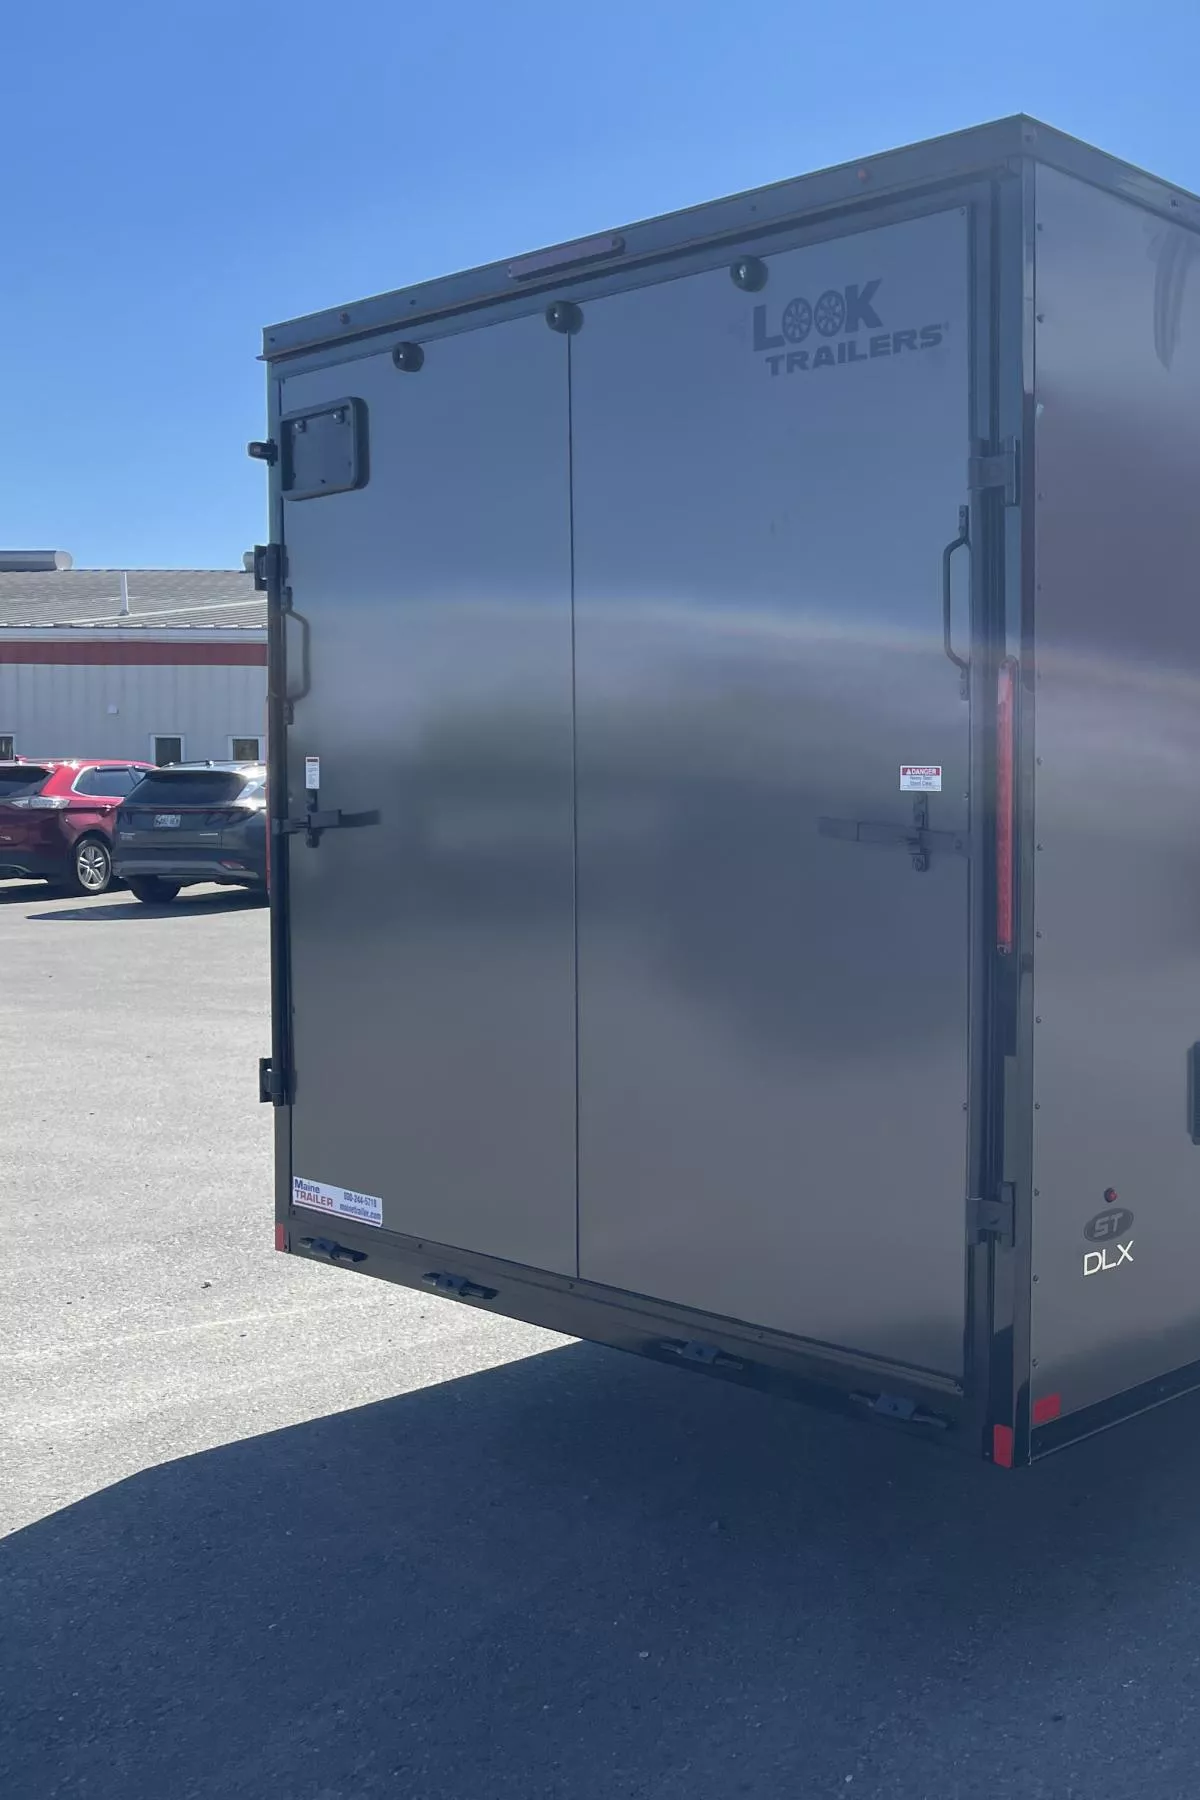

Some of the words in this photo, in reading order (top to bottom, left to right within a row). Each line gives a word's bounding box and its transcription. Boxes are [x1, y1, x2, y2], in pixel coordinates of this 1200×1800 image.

[753, 277, 884, 352] LOOK
[765, 325, 944, 377] TRAILERS
[294, 1178, 321, 1194] Maine
[294, 1189, 334, 1208] TRAILER
[1093, 1212, 1124, 1238] ST
[1083, 1240, 1134, 1276] DLX
